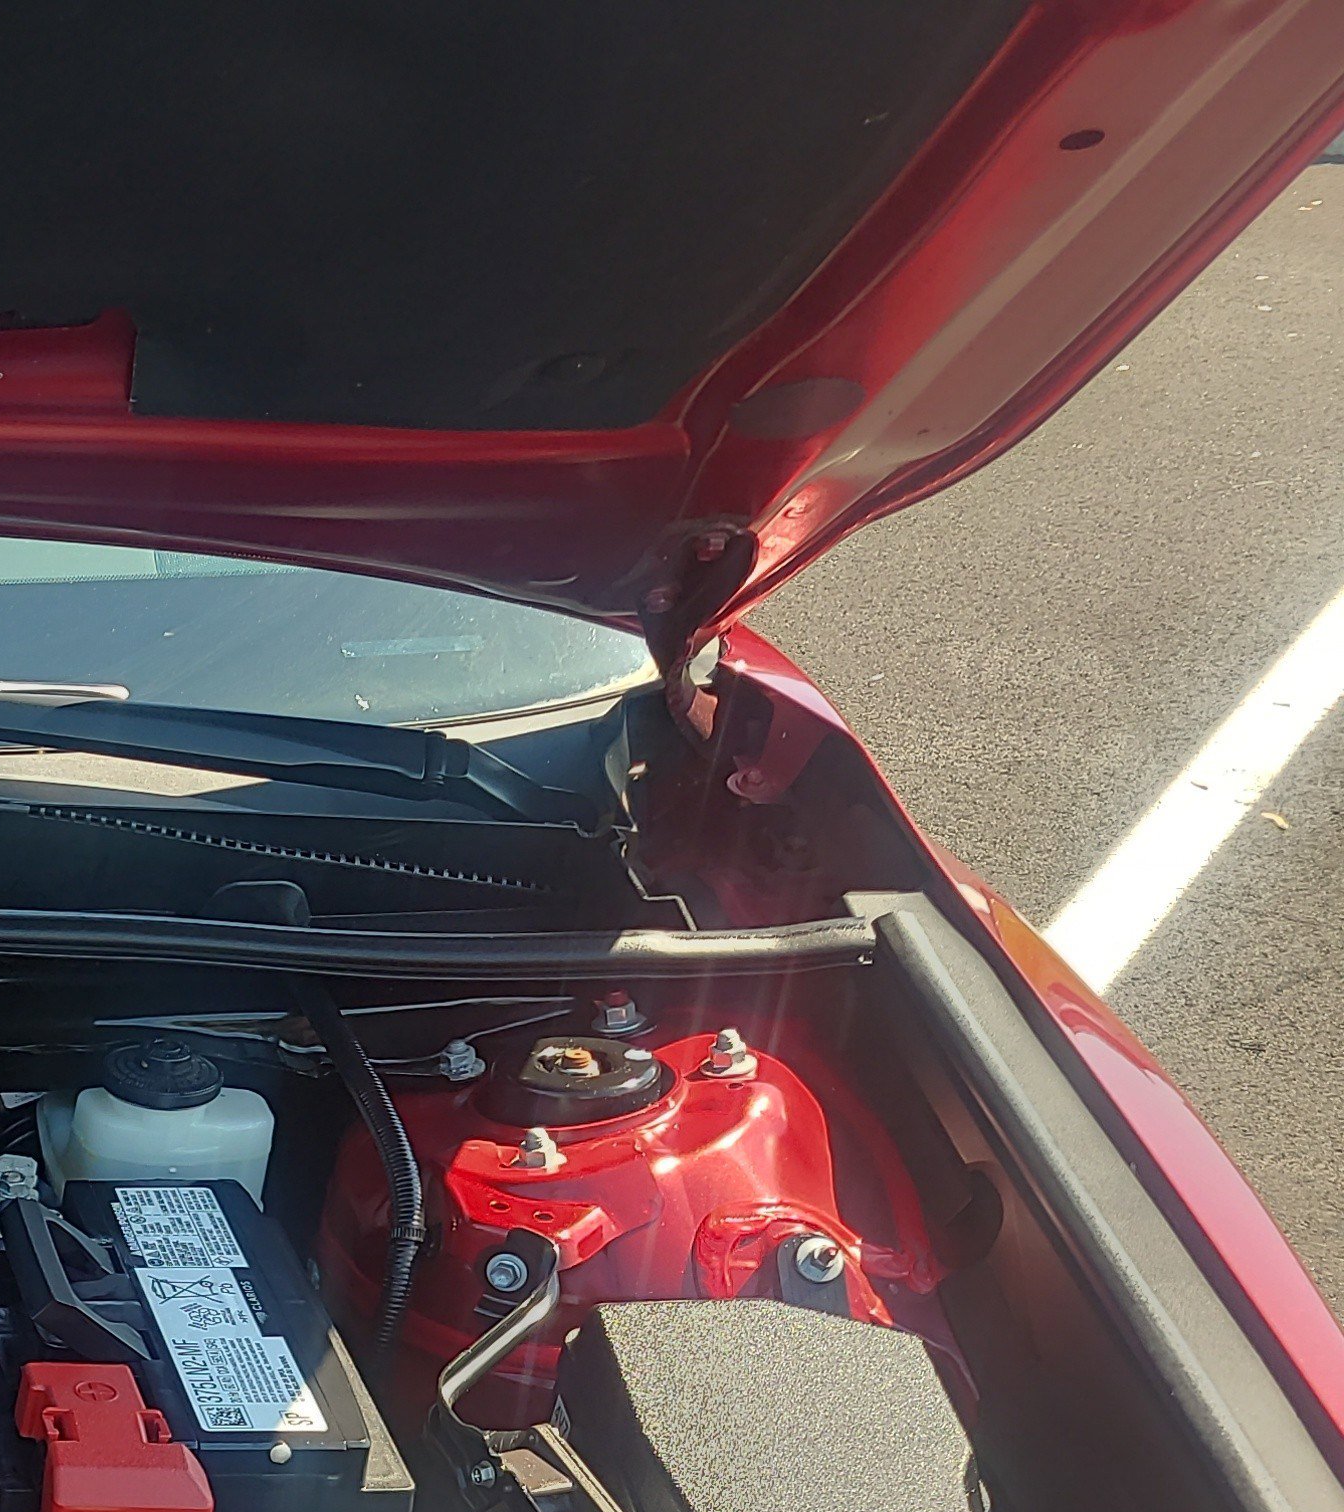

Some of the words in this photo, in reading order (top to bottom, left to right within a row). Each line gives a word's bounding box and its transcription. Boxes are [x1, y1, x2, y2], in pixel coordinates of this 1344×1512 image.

[240, 1280, 262, 1311] CLARIOS
[172, 1338, 223, 1403] 375LN2-MF
[285, 1412, 314, 1426] SP
